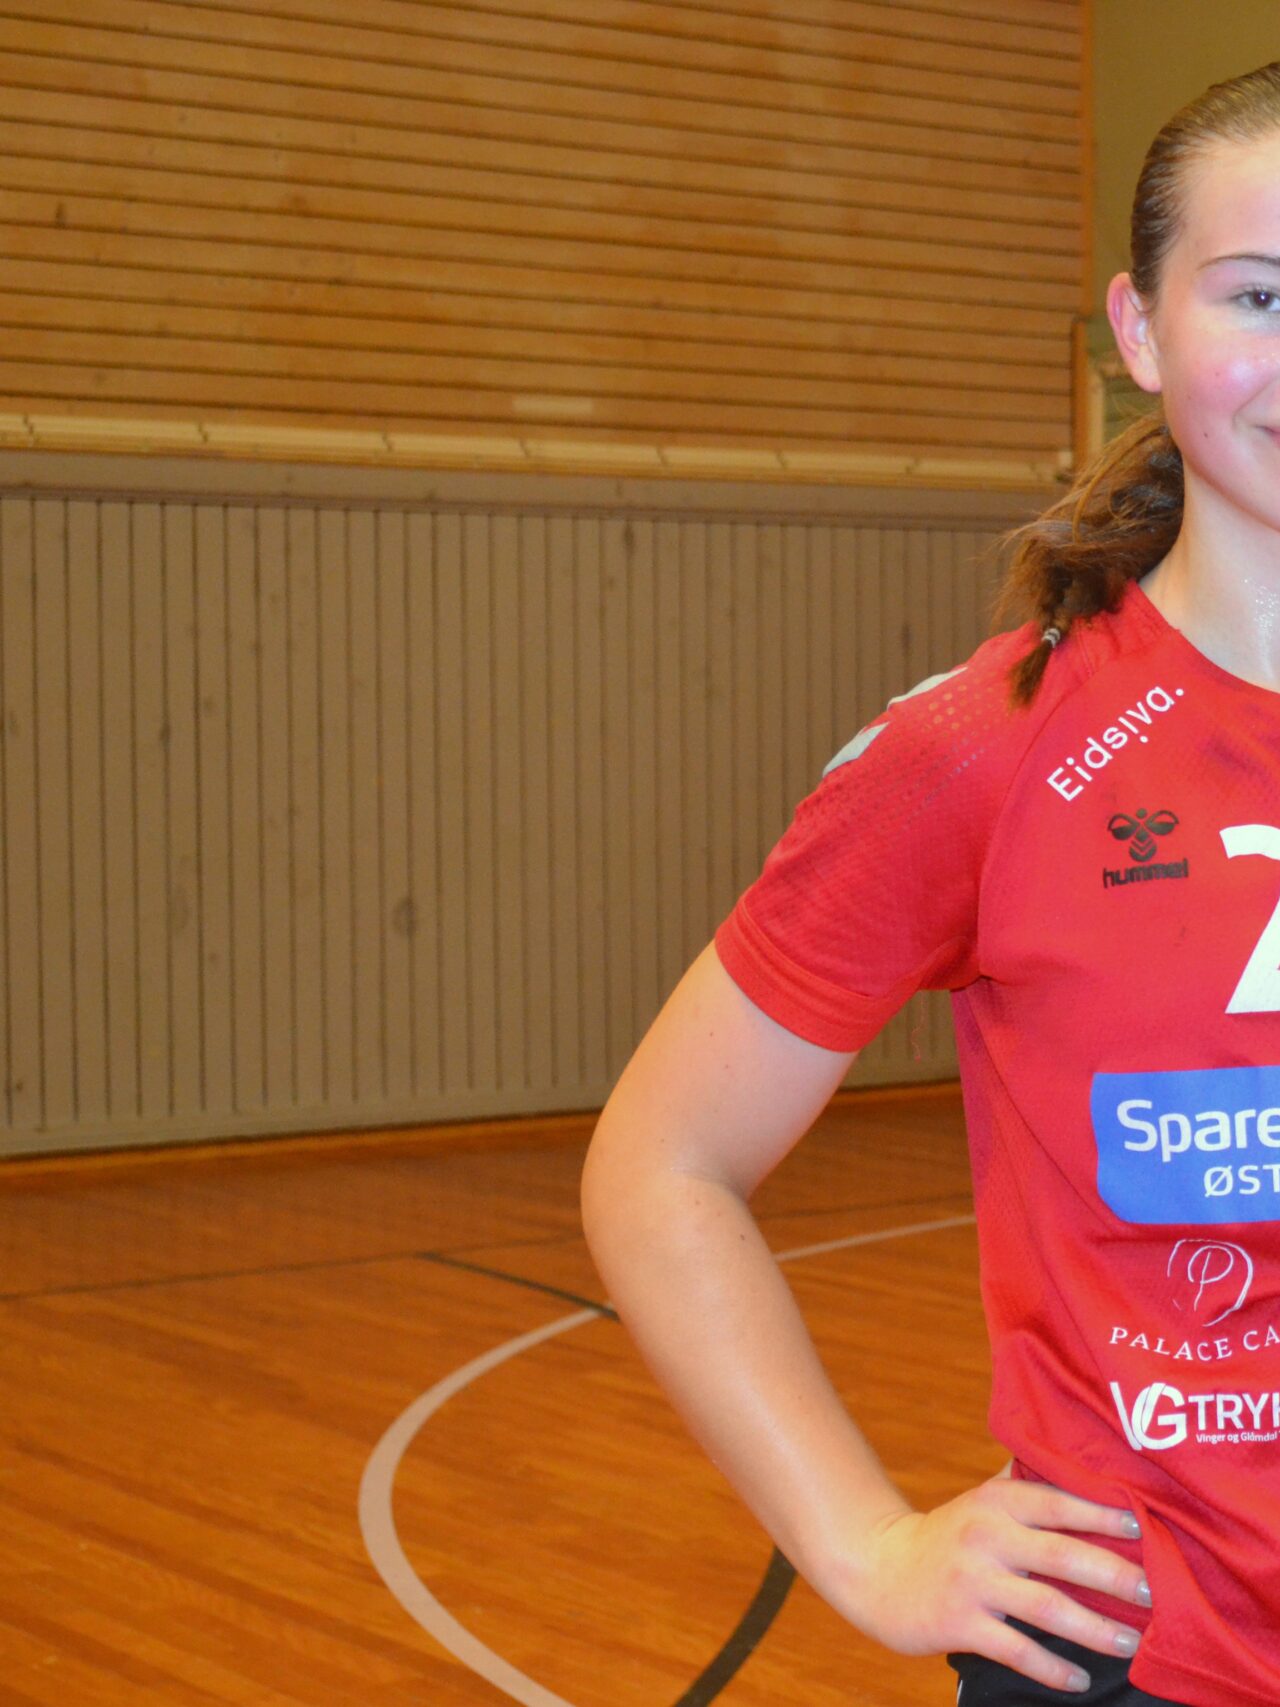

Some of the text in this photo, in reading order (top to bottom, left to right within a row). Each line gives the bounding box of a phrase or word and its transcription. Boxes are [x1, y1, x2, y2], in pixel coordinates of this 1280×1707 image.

[1102, 857, 1189, 889] hummel
[1109, 1326, 1234, 1362] PALACE
[1196, 1433, 1226, 1445] Vinger
[1227, 1434, 1240, 1444] og
